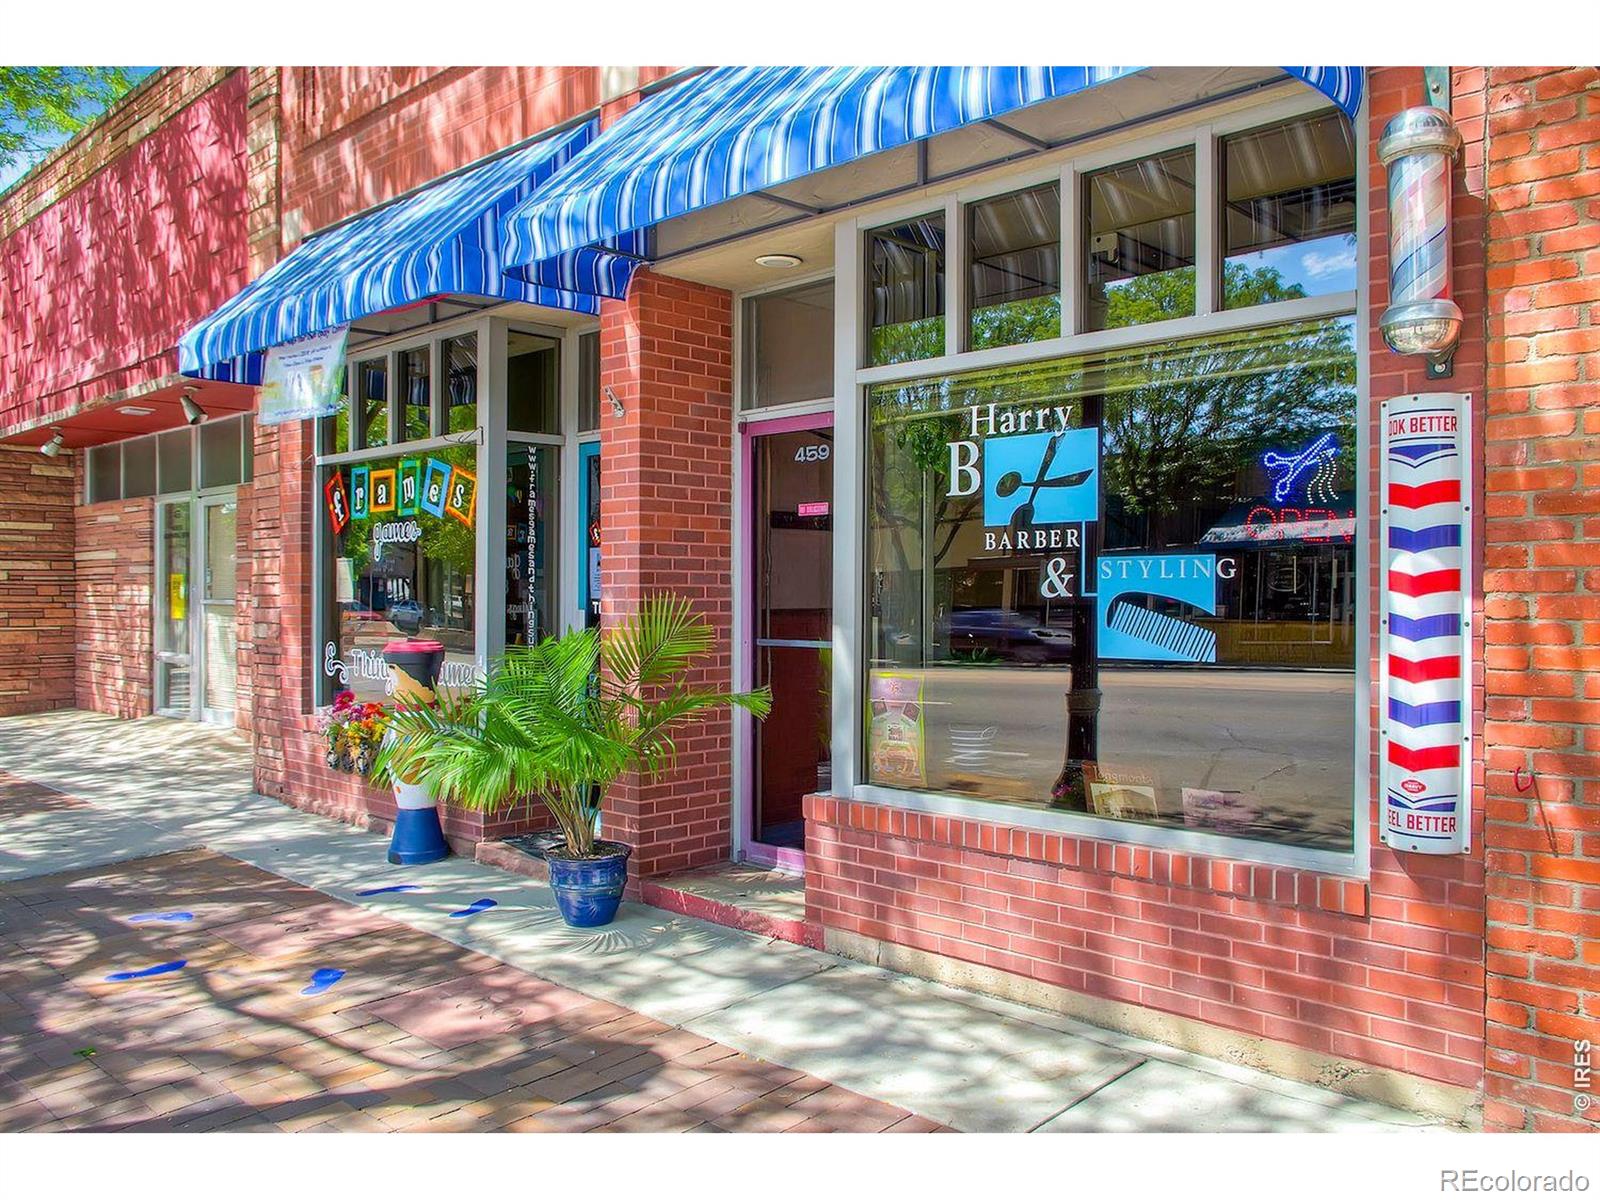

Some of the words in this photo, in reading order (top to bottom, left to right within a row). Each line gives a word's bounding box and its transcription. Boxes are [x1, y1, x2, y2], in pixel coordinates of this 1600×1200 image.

[969, 403, 1073, 437] Harry
[1409, 415, 1458, 434] BETTER
[794, 444, 830, 462] 459
[945, 440, 981, 497] B
[333, 474, 466, 523] frames
[984, 528, 1081, 551] BARBER
[1246, 505, 1355, 543] OPEN
[1040, 556, 1074, 598] &
[1100, 557, 1238, 580] STYLING
[1388, 808, 1402, 828] EEL
[1406, 813, 1457, 833] BETTER
